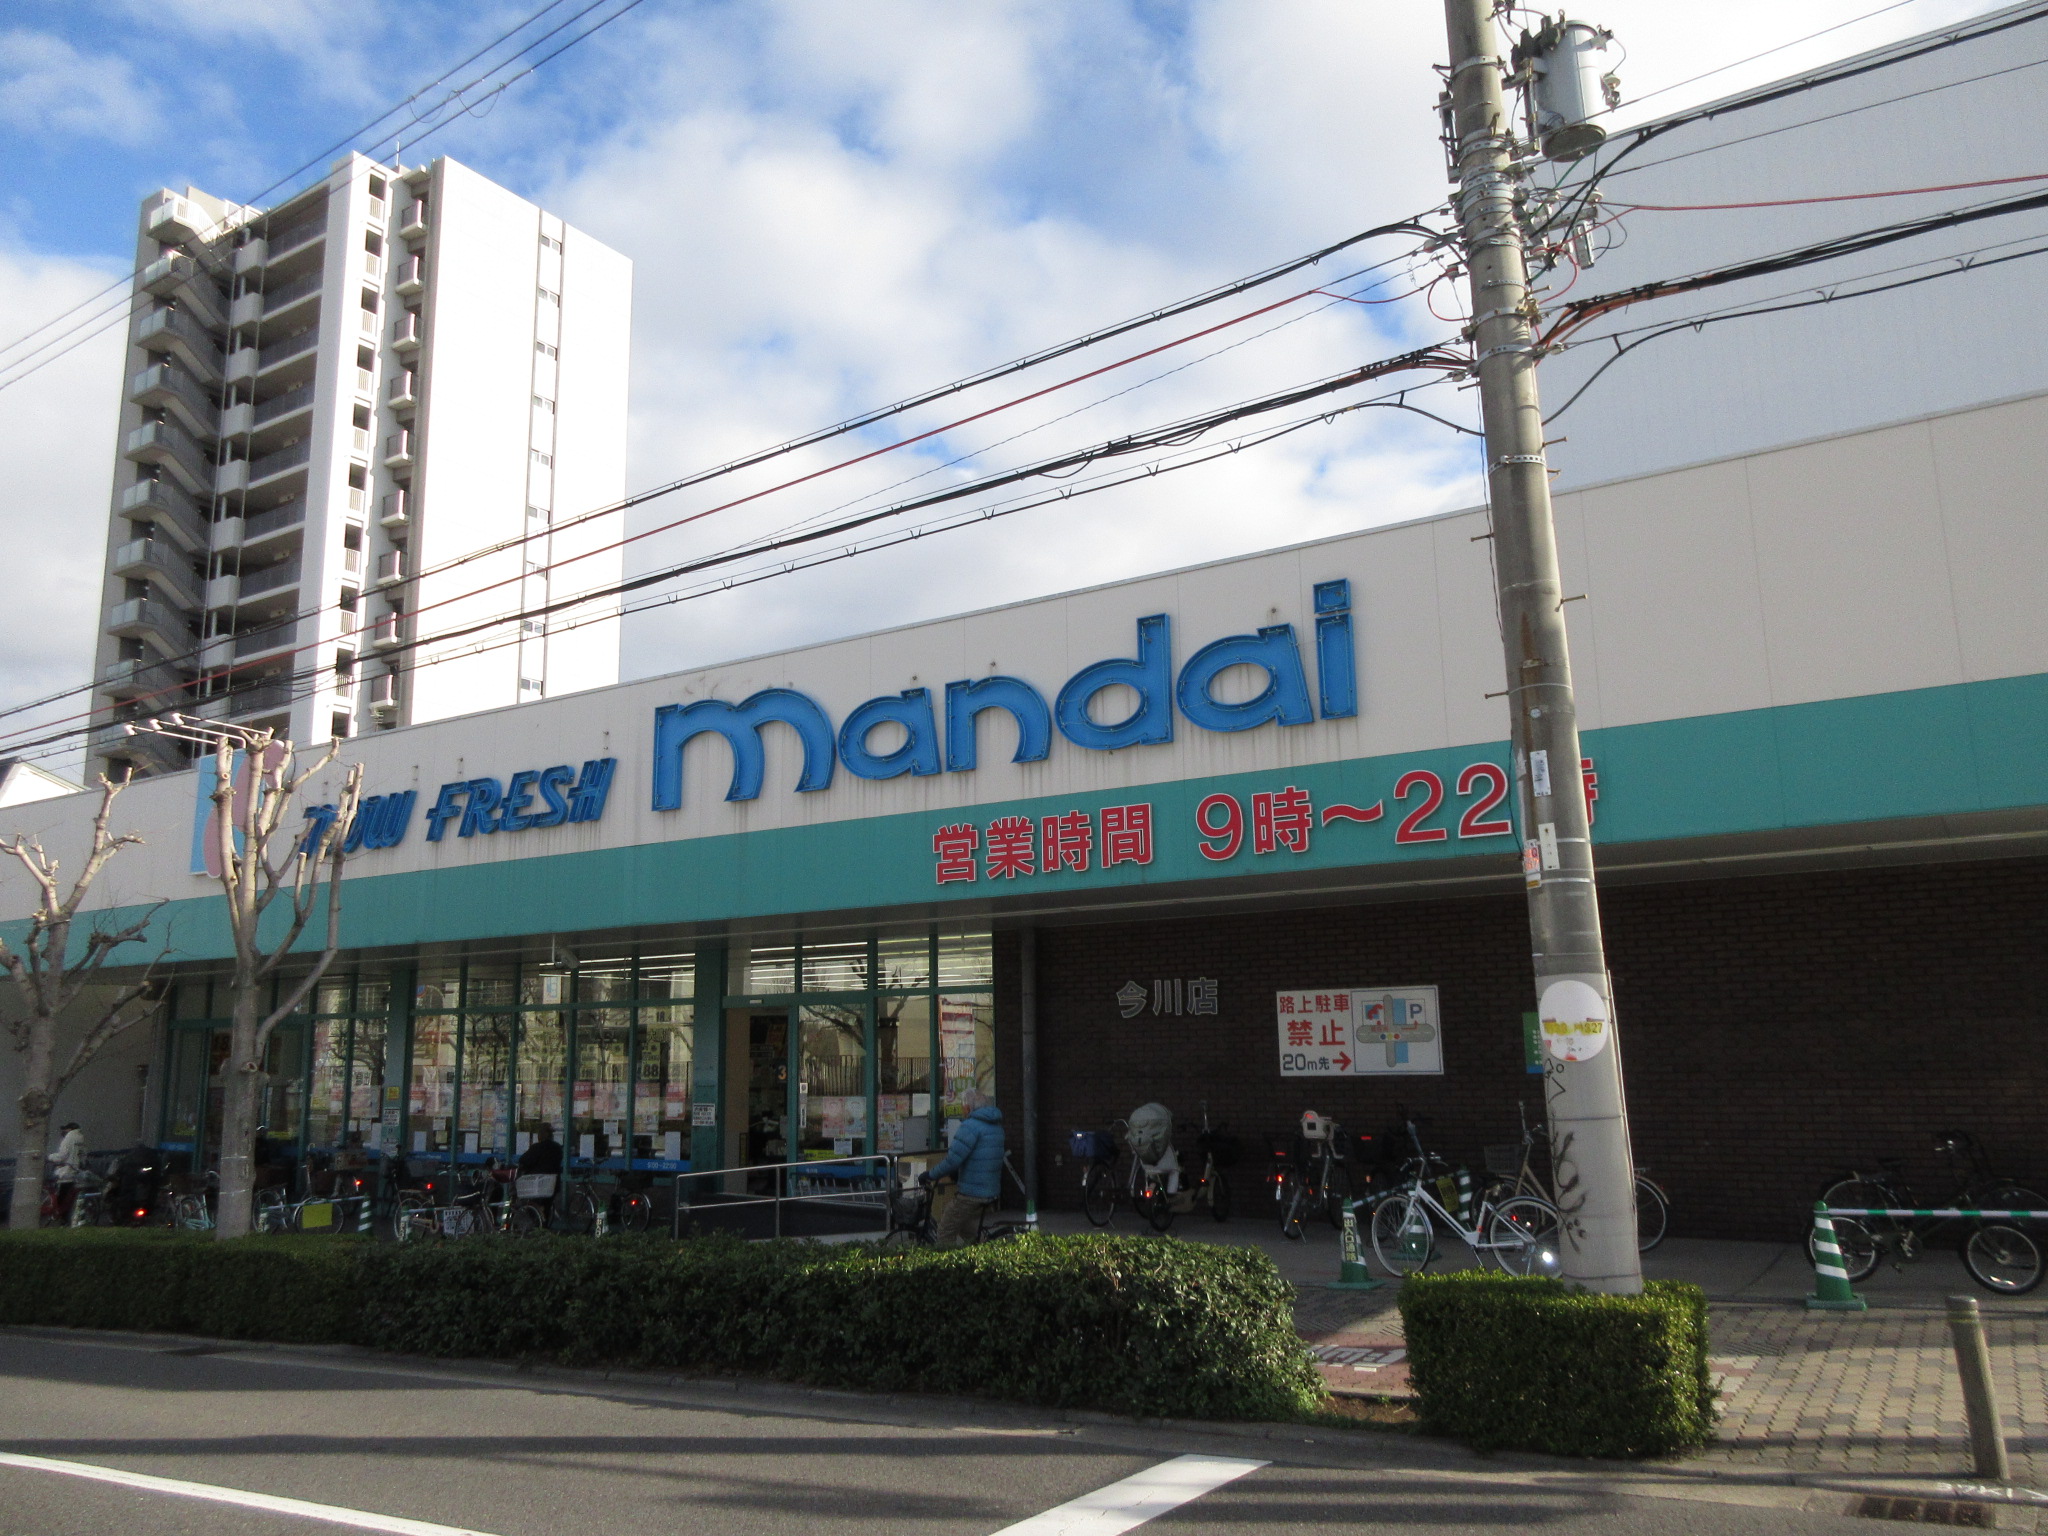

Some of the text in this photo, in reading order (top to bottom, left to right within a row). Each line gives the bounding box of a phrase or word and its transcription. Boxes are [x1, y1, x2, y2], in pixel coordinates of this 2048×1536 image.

[651, 577, 1359, 813] mandai
[425, 757, 618, 843] FRESH
[931, 802, 1155, 886] 営業時間
[1115, 976, 1219, 1018] 今川店
[1279, 993, 1350, 1015] 路上駐車
[1410, 1003, 1422, 1019] P
[1286, 1020, 1346, 1047] 禁止
[1282, 1053, 1330, 1072] 20m先
